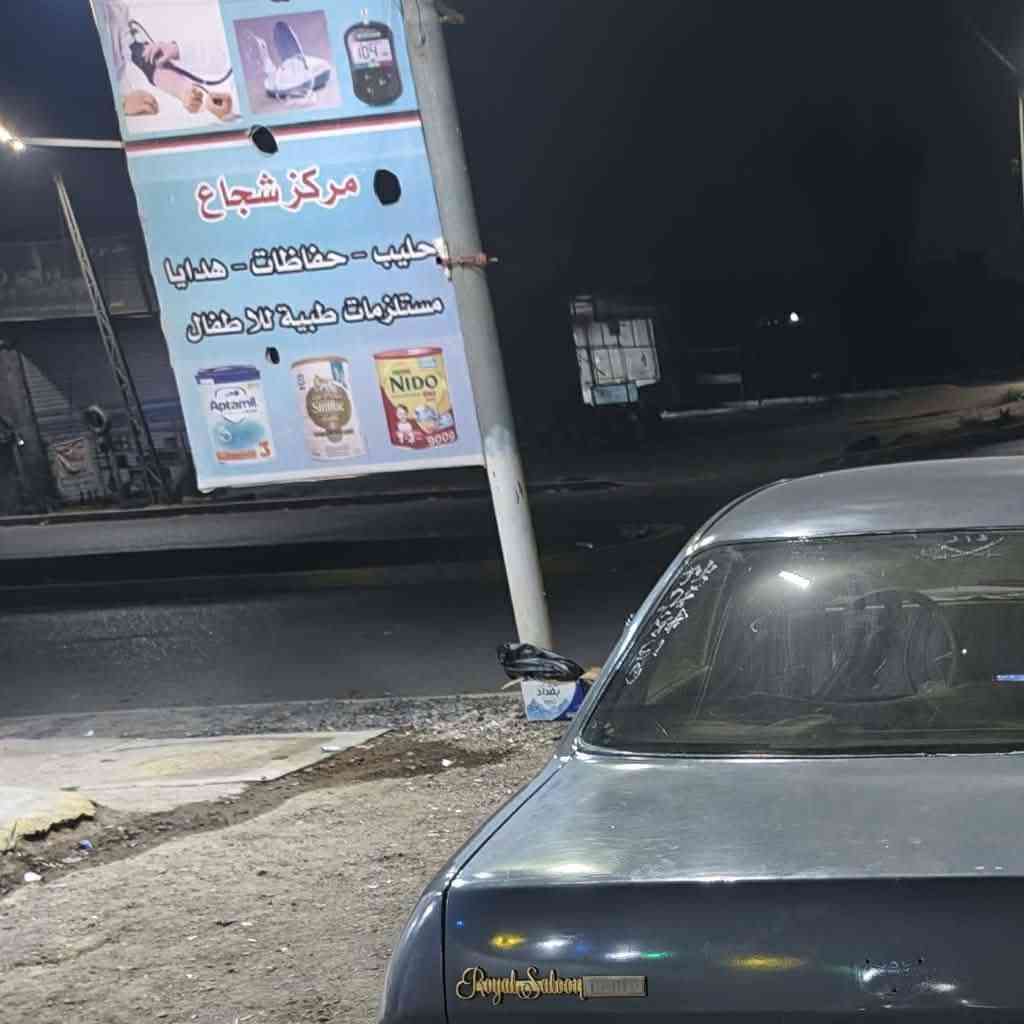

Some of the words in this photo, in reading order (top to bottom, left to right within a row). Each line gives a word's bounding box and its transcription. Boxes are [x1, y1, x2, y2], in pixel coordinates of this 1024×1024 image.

[197, 171, 280, 221] شجاع
[285, 166, 359, 210] مركز
[250, 244, 348, 277] حفاظات
[372, 234, 439, 269] حليب
[164, 258, 229, 290] هدايا
[276, 301, 338, 333] طبية
[342, 292, 444, 325] مستلزمات
[389, 375, 439, 393] NIDO
[210, 397, 257, 413] Aptamil
[456, 966, 518, 1006] Royal
